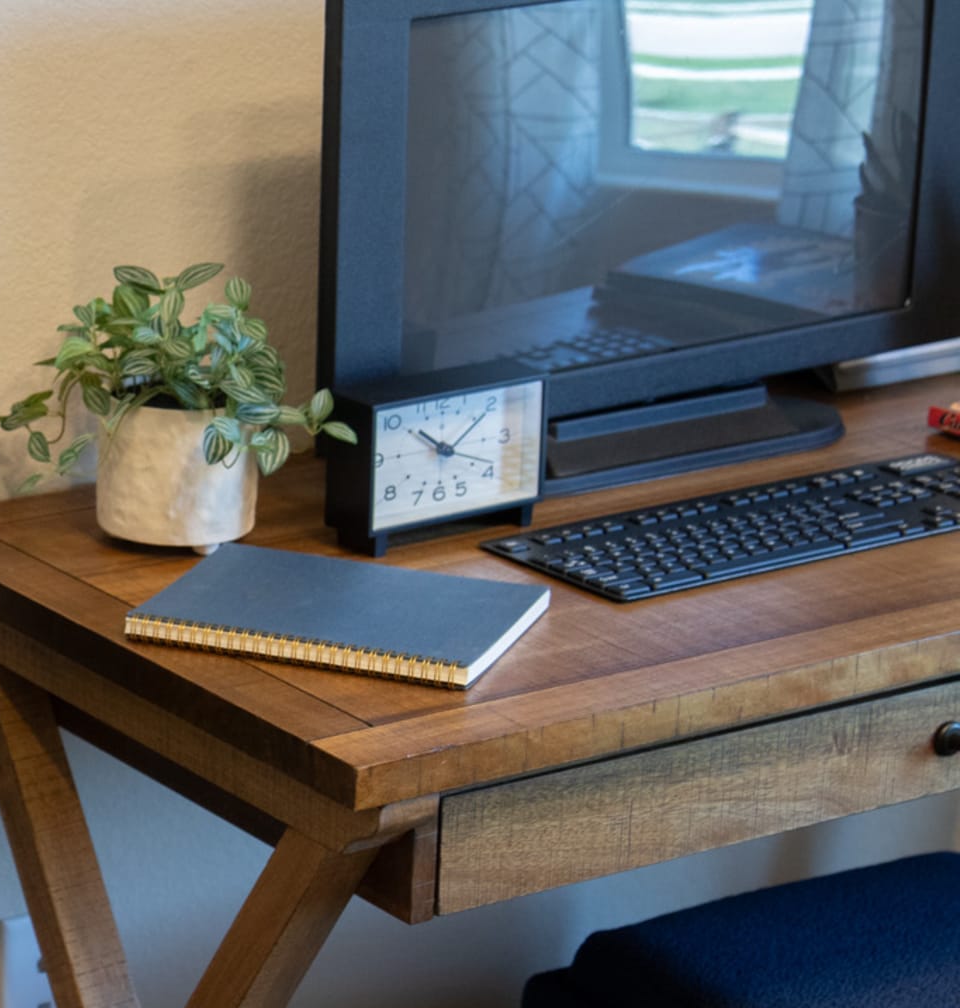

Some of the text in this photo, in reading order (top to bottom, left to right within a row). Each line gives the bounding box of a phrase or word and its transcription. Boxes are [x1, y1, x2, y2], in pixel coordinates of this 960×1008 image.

[485, 396, 497, 412] 2
[383, 414, 402, 432] 10
[498, 428, 511, 444] 3
[374, 452, 385, 469] 9
[481, 465, 494, 478] 4
[383, 485, 397, 501] 8
[432, 486, 446, 501] 6
[455, 481, 467, 497] 5
[412, 489, 424, 506] 7
